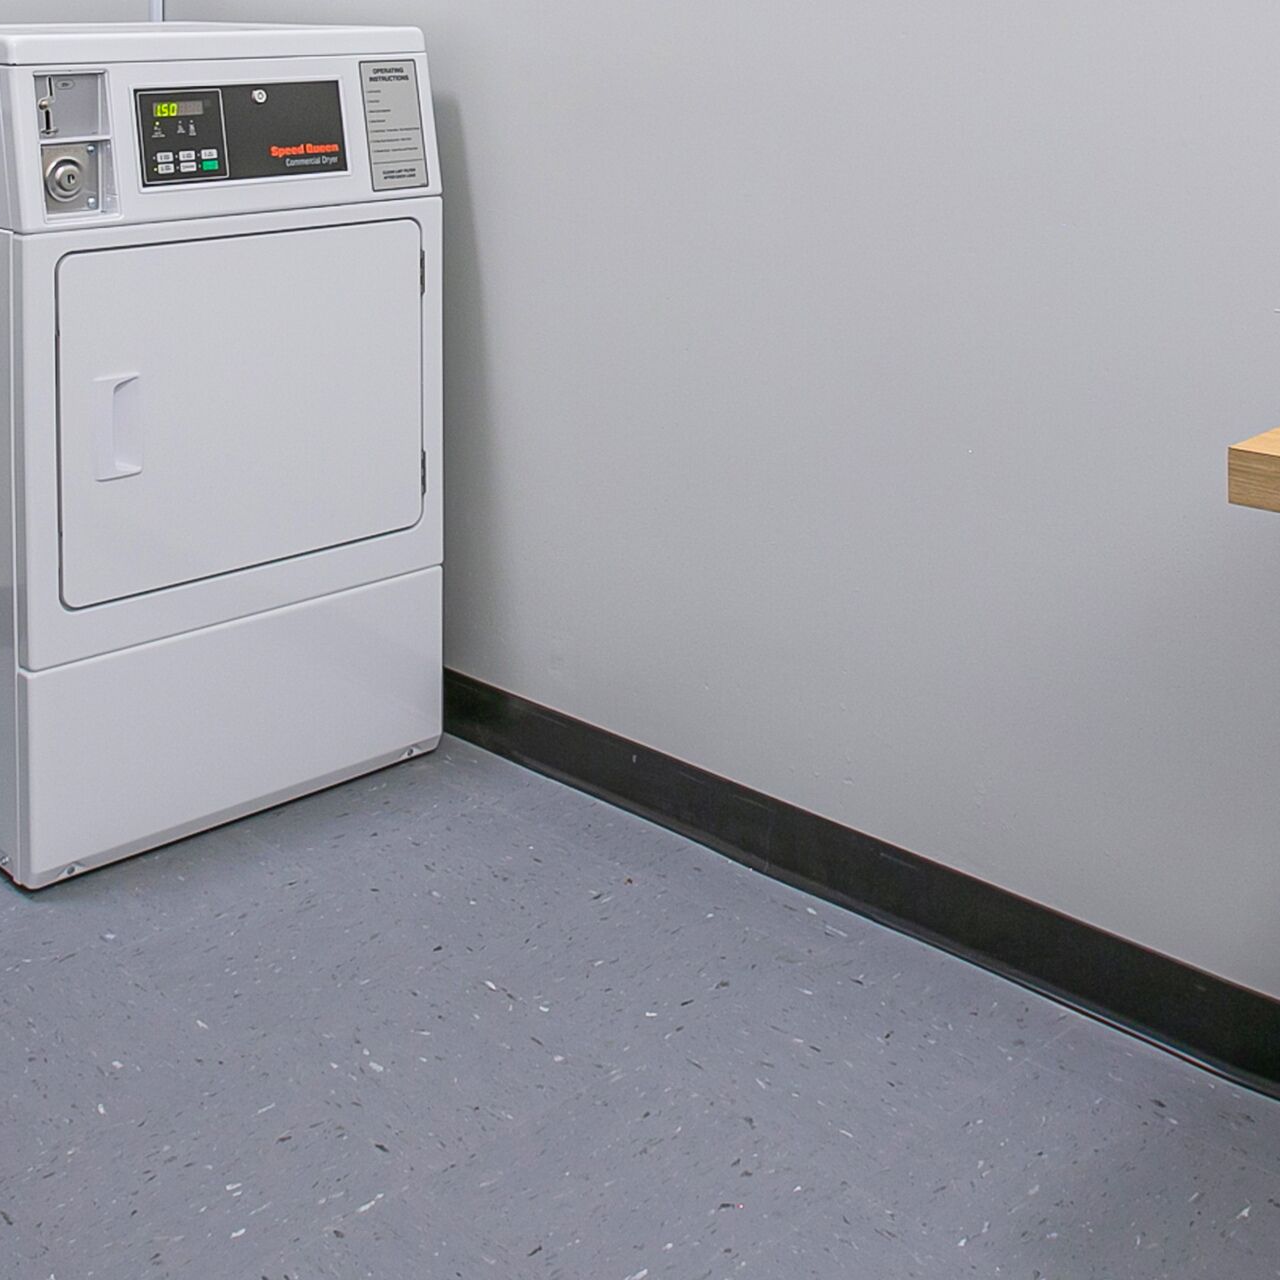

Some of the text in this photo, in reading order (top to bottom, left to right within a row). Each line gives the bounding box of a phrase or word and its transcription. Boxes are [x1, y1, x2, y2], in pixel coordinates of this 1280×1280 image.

[372, 67, 404, 75] OPERATING
[270, 143, 339, 158] Speed Queen
[285, 155, 339, 167] Commercial Dryer
